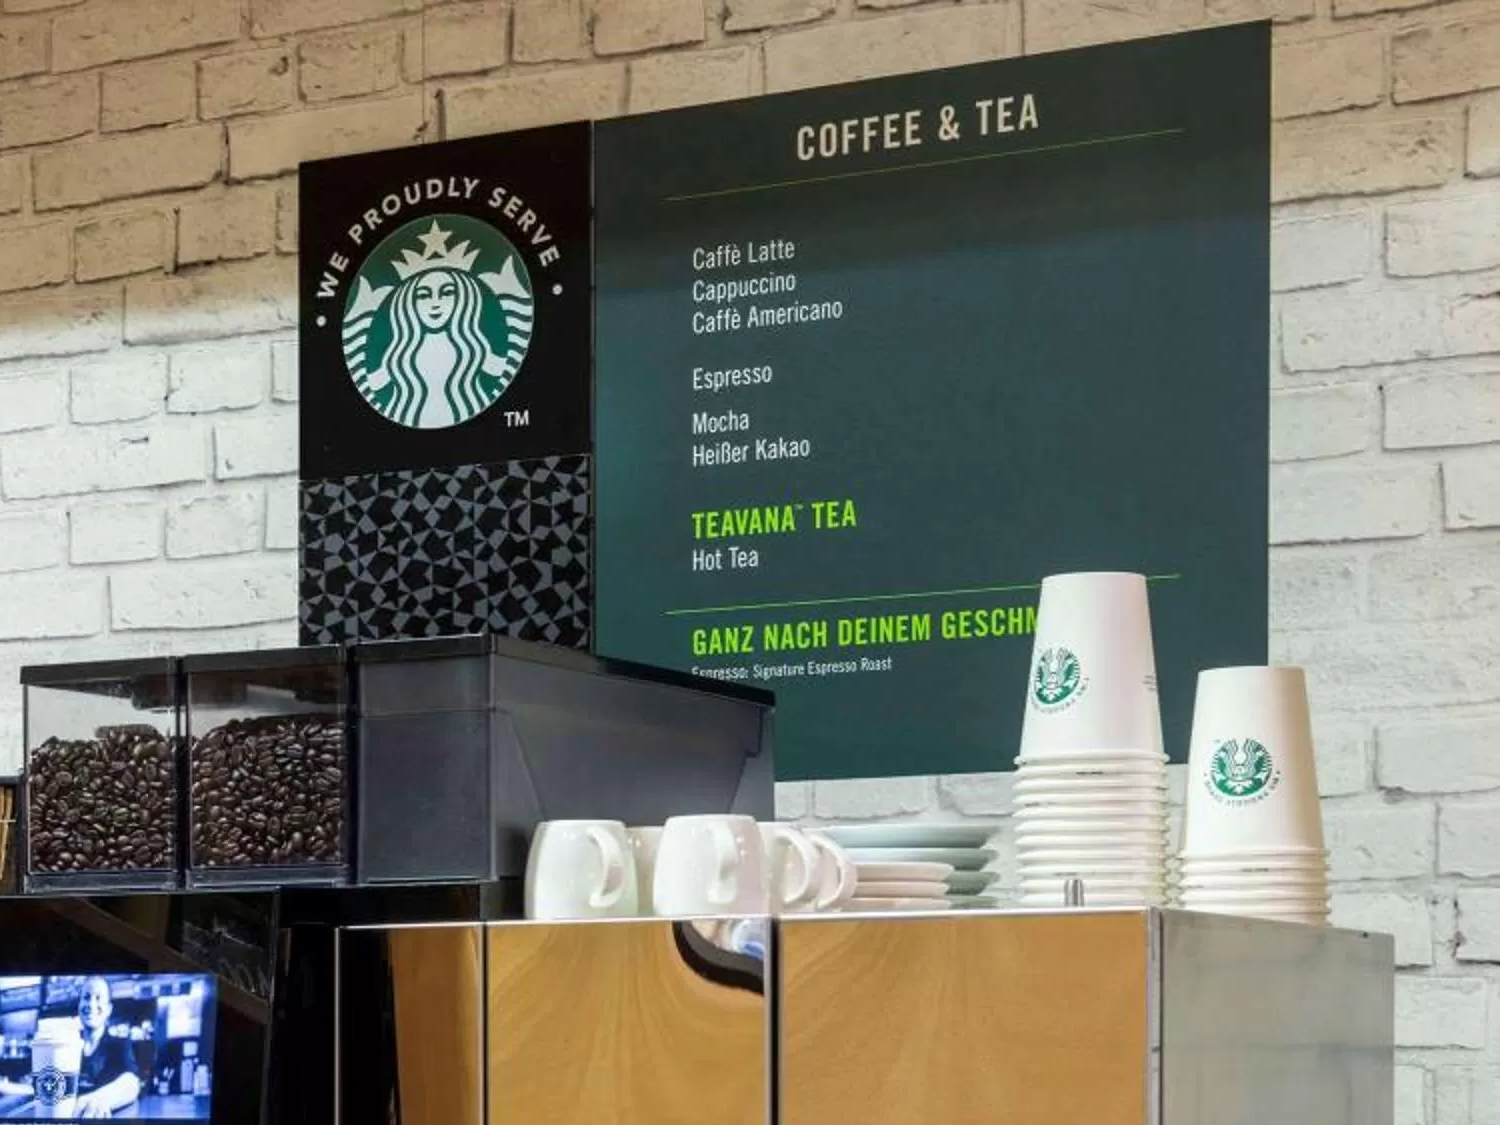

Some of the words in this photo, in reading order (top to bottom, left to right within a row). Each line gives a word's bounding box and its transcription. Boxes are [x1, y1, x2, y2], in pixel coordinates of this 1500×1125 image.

[796, 109, 922, 161] COFFEE
[938, 105, 961, 142] &
[975, 93, 1040, 135] TEA
[316, 251, 350, 299] WE
[348, 176, 481, 245] PROUDLY
[487, 186, 562, 267] SERVE
[692, 242, 742, 271] Caffè
[747, 239, 796, 265] Latte
[692, 271, 797, 303] Cappuccino
[692, 306, 742, 335] Caffè
[747, 300, 843, 328] Americano
[692, 363, 773, 393] Espresso
[692, 411, 750, 436] Mocha
[692, 440, 748, 468] Heißer
[754, 437, 811, 462] Kakao
[691, 505, 796, 539] TEAVANA
[811, 499, 858, 529] TEA
[692, 548, 723, 572] Hot
[728, 546, 760, 569] Tea
[692, 624, 755, 656] GANZ
[763, 620, 828, 651] NACH
[837, 612, 932, 648] DEINEM
[752, 662, 805, 680] Signature
[807, 659, 857, 677] Espresso
[860, 655, 893, 672] Roast
